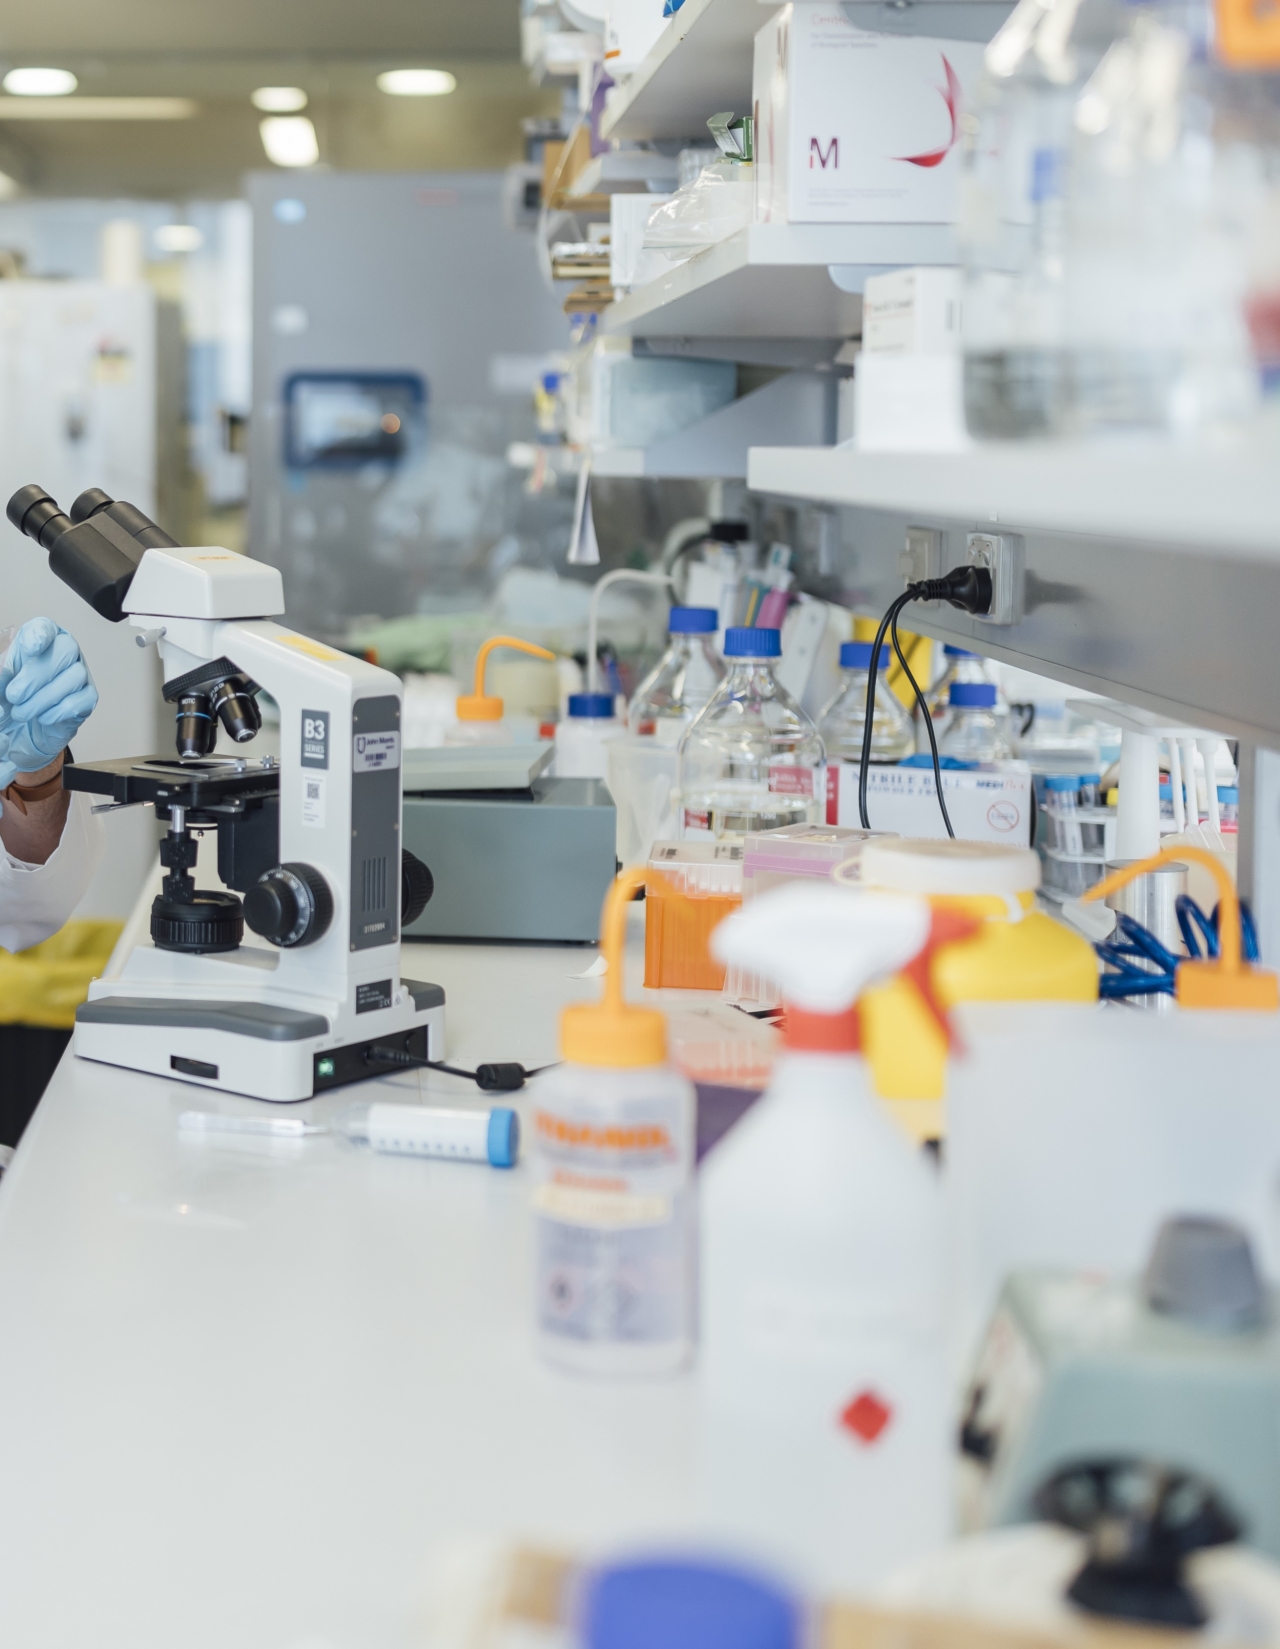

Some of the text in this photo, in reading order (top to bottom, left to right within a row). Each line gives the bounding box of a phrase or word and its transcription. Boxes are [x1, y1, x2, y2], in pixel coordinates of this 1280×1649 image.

[810, 137, 837, 169] M
[304, 718, 325, 740] B3
[304, 743, 325, 754] SERIES
[852, 771, 964, 789] NTRILE BUE
[919, 788, 947, 798] FRE
